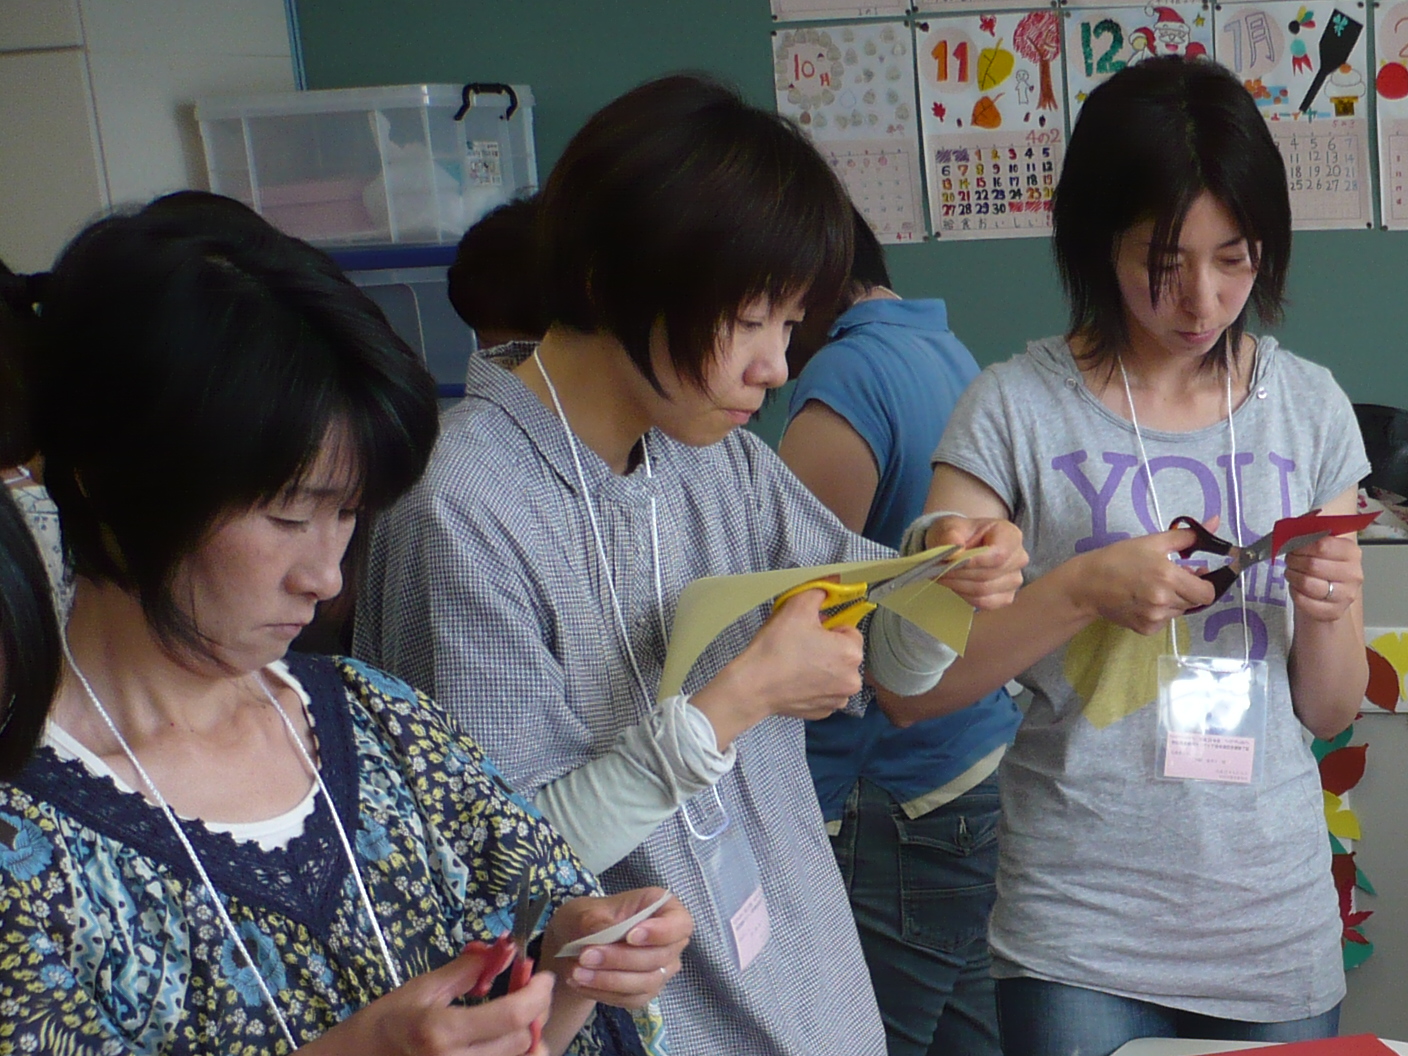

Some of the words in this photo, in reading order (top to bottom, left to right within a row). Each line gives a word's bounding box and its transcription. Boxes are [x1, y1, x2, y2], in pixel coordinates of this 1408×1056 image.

[1081, 18, 1126, 77] 12
[1224, 11, 1275, 73] 1月
[930, 39, 968, 83] 11
[1290, 138, 1299, 150] 4
[1310, 137, 1318, 149] 5
[1328, 138, 1336, 151] 6
[975, 149, 982, 161] 1
[991, 148, 1000, 160] 2
[1008, 148, 1017, 160] 3
[1024, 147, 1034, 159] 4
[1042, 147, 1050, 158] 5
[1290, 153, 1299, 163] 11
[1309, 151, 1320, 161] 12
[1326, 151, 1338, 163] 13
[942, 165, 951, 176] 6
[958, 164, 968, 176] 7
[976, 163, 984, 175] 8
[993, 164, 1000, 175] 9
[1009, 164, 1018, 173] 10
[1026, 162, 1036, 172] 11
[1042, 161, 1053, 172] 12
[1290, 166, 1301, 178] 18
[1309, 166, 1320, 177] 19
[1326, 165, 1341, 177] 20
[942, 178, 952, 190] 13
[959, 178, 970, 189] 14
[976, 177, 987, 188] 15
[993, 176, 1002, 187] 16
[1009, 176, 1020, 187] 17
[1026, 174, 1038, 186] 18
[1290, 180, 1303, 190] 25
[1306, 180, 1322, 190] 26
[1326, 180, 1339, 191] 27
[942, 192, 955, 202] 20
[958, 190, 971, 201] 21
[975, 189, 989, 201] 22
[991, 189, 1006, 200] 23
[1008, 188, 1022, 200] 24
[1026, 187, 1042, 199] 25
[942, 204, 956, 216] 27
[958, 203, 972, 216] 28
[975, 202, 990, 214] 29
[992, 203, 1006, 214] 30
[1051, 449, 1297, 553] YOU
